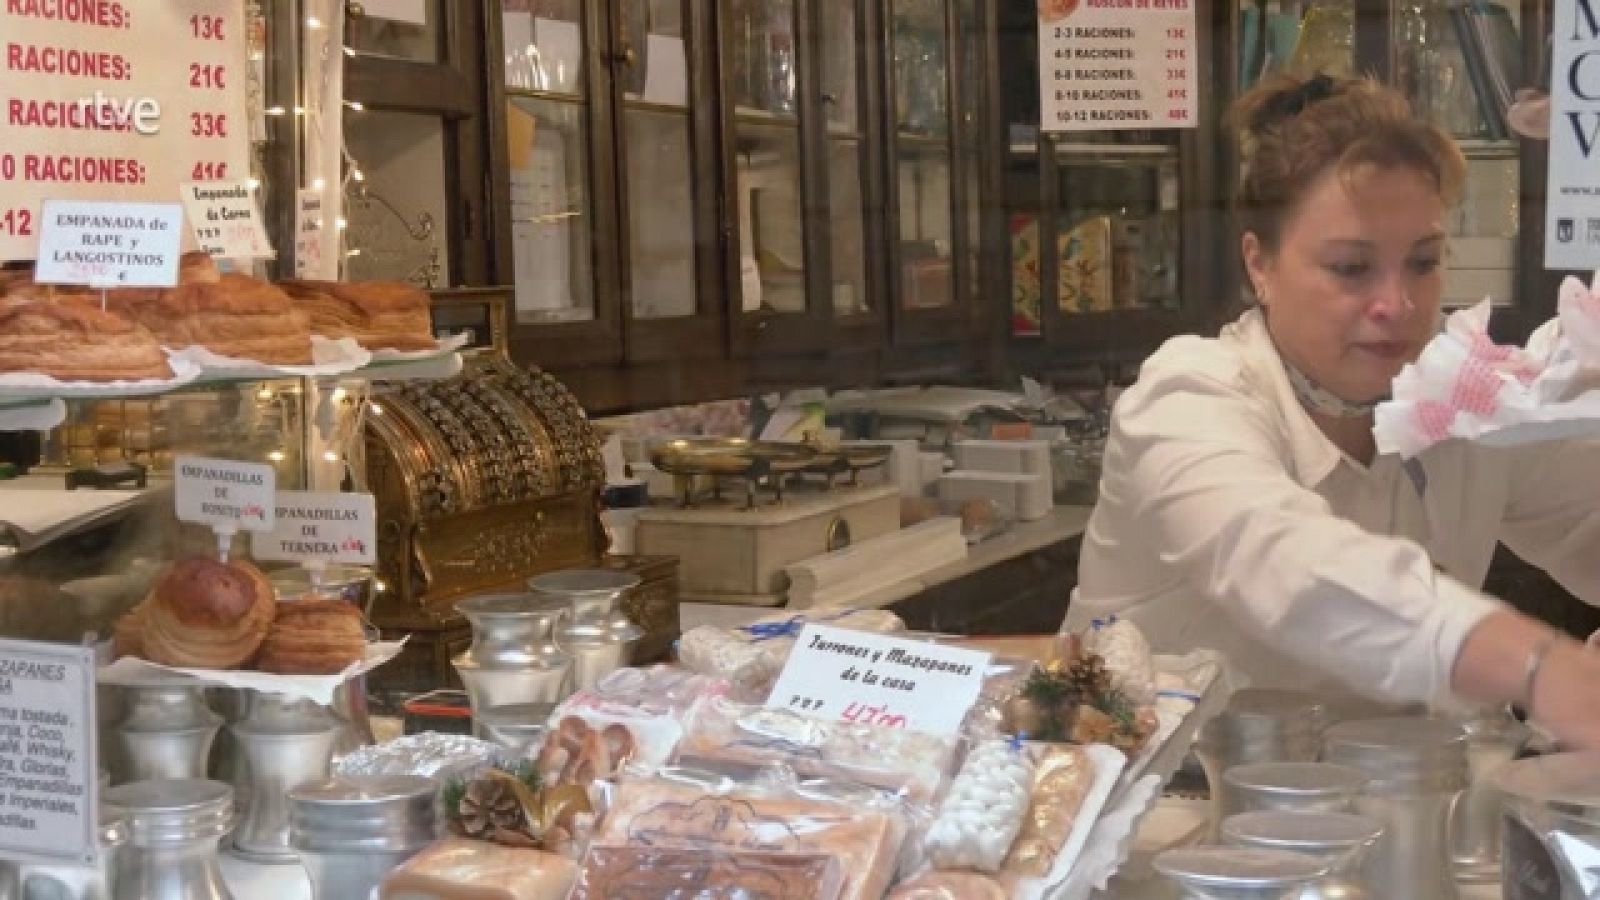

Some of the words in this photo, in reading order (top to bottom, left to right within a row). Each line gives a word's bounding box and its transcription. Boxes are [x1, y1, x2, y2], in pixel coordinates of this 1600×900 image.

[6, 0, 131, 29] RACIONES:
[190, 15, 225, 41] 13€
[1075, 27, 1135, 38] RACIONES:
[1075, 49, 1135, 60] RACIONES:
[6, 44, 131, 81] RACIONES:
[190, 63, 226, 89] 21€
[1075, 69, 1135, 80] RACIONES:
[1090, 109, 1152, 121] RACIONES:
[191, 112, 226, 138] 33€
[24, 154, 146, 184] RACIONES:
[56, 214, 146, 231] EMPANADA
[149, 217, 168, 231] de
[81, 234, 122, 247] RAPE
[130, 238, 139, 250] y
[53, 249, 164, 266] LANGOSTINOS
[181, 464, 264, 486] EMPANADILLAS
[214, 486, 228, 499] DE
[302, 524, 317, 537] DE
[280, 540, 338, 555] TERNERA
[808, 634, 868, 659] Turrones
[871, 650, 883, 663] y
[884, 647, 974, 676] Mazapanes
[840, 665, 860, 681] de
[882, 676, 916, 691] casa
